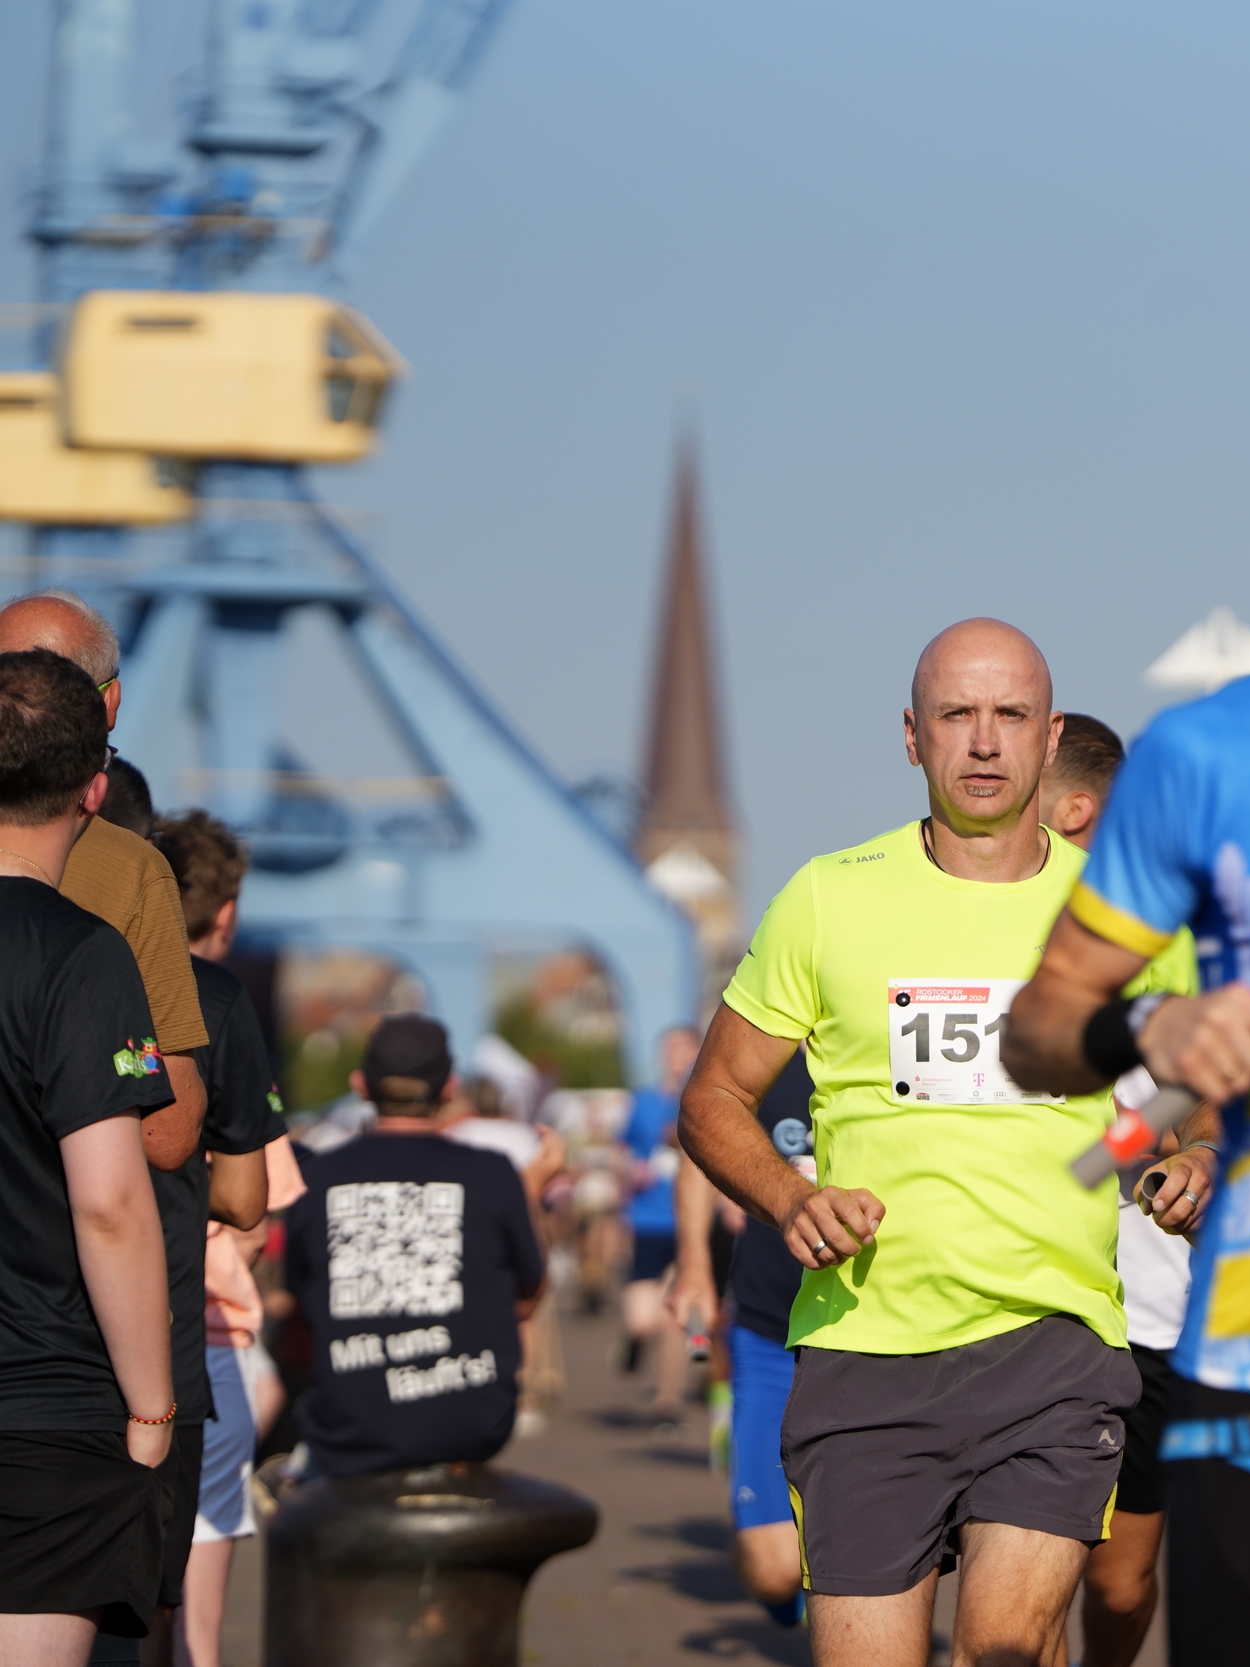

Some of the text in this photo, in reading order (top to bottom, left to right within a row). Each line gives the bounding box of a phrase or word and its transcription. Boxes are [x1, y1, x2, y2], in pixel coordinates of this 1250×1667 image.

[856, 852, 885, 863] JAKO
[915, 994, 968, 1002] FIRMENLAUF
[329, 1325, 452, 1374] Mit uns
